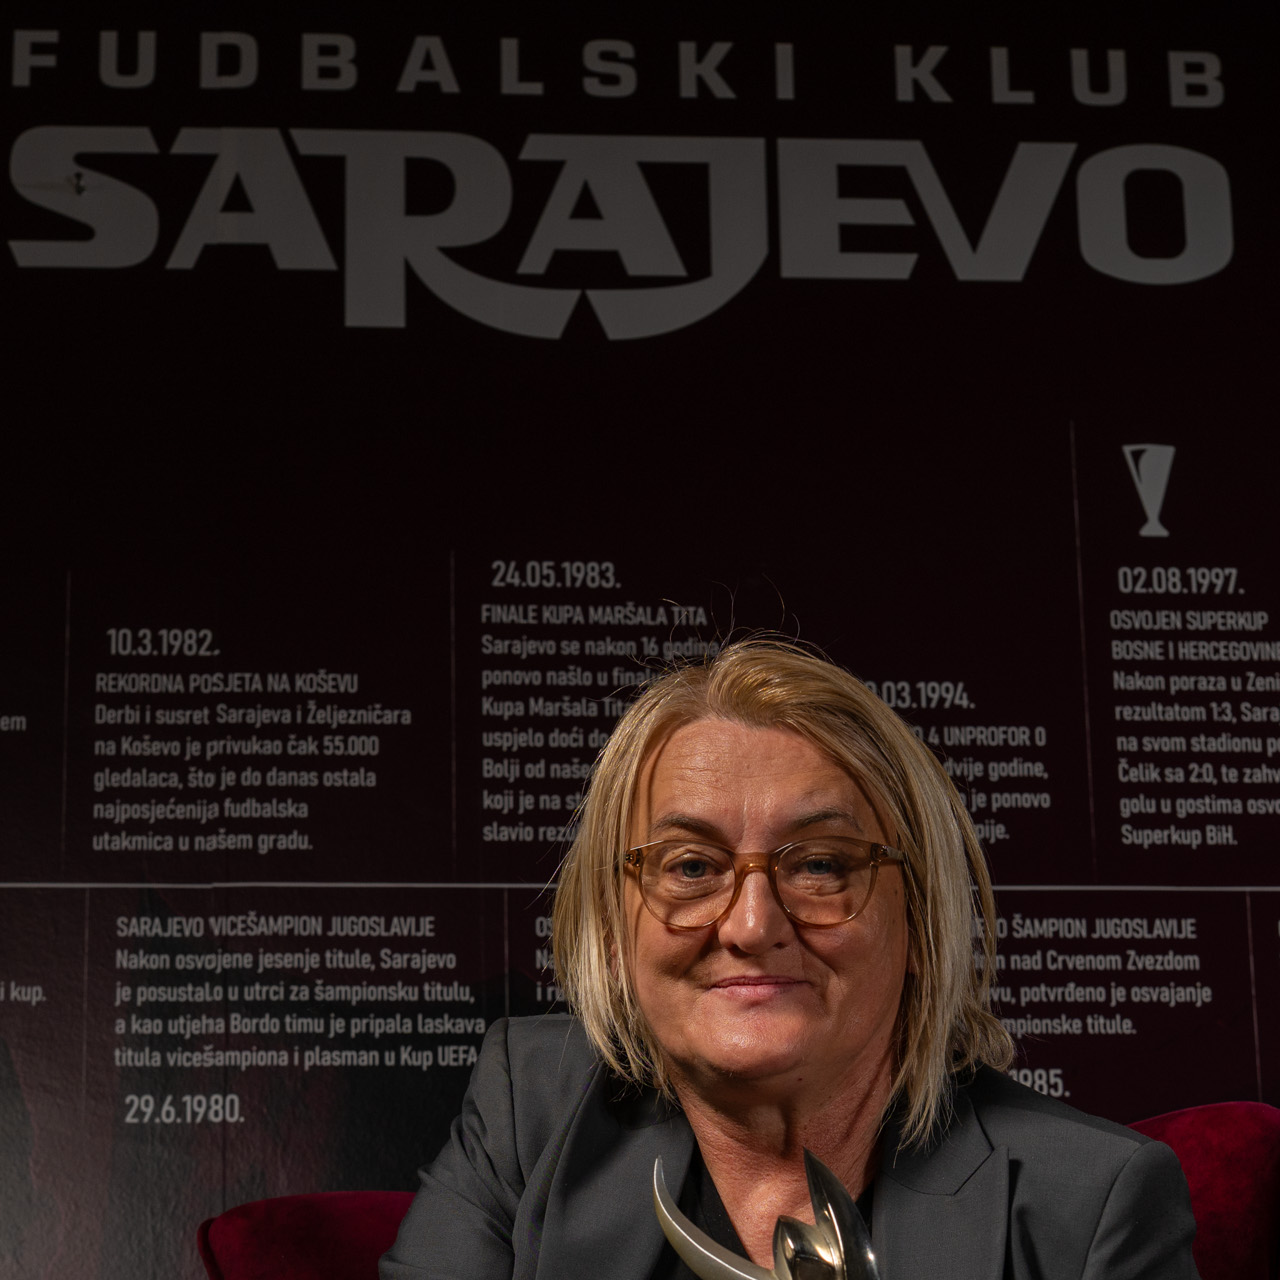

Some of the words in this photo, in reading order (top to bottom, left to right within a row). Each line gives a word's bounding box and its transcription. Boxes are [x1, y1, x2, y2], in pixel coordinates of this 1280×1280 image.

[12, 29, 795, 100] FUDBALSKI
[893, 44, 1225, 109] KLUB
[7, 125, 1235, 341] SARAJEVO
[491, 560, 622, 589] 24.05.1983.
[1117, 566, 1245, 595] 02.08.1997.
[480, 603, 538, 625] FINALE
[542, 604, 586, 625] KUPA
[588, 600, 669, 626] MARŠALA
[673, 604, 709, 626] TITA
[1109, 609, 1182, 630] OSVOJEN
[1185, 610, 1269, 631] SUPERKUP
[106, 627, 221, 657] 10.3.1982.
[1111, 639, 1165, 661] BOSNE
[1168, 641, 1175, 660] I
[95, 672, 185, 694] REKORDNA
[188, 672, 263, 694] POSJETA
[267, 673, 291, 693] NA
[295, 668, 359, 694] KOŠEVU
[927, 726, 941, 746] 4
[943, 725, 1031, 748] UNPROFOR
[92, 831, 174, 852] utakmica
[178, 835, 190, 852] u
[194, 827, 253, 852] našem
[257, 829, 314, 855] gradu.
[1120, 824, 1202, 850] Superkup
[1205, 824, 1238, 846] BiH.
[116, 916, 205, 938] SARAJEVO
[208, 910, 323, 937] VICEŠAMPION
[326, 915, 435, 937] JUGOSLAVIJE
[1011, 913, 1087, 939] ŠAMPION
[1091, 917, 1197, 940] JUGOSLAVIJE
[115, 949, 171, 970] Nakon
[257, 947, 321, 974] jesenje
[324, 948, 376, 971] titule,
[379, 947, 457, 974] Sarajevo
[1010, 949, 1043, 971] nad
[1046, 949, 1122, 971] Crvenom
[1126, 949, 1200, 971] Zvezdom
[124, 1093, 245, 1124] 29.6.1980.
